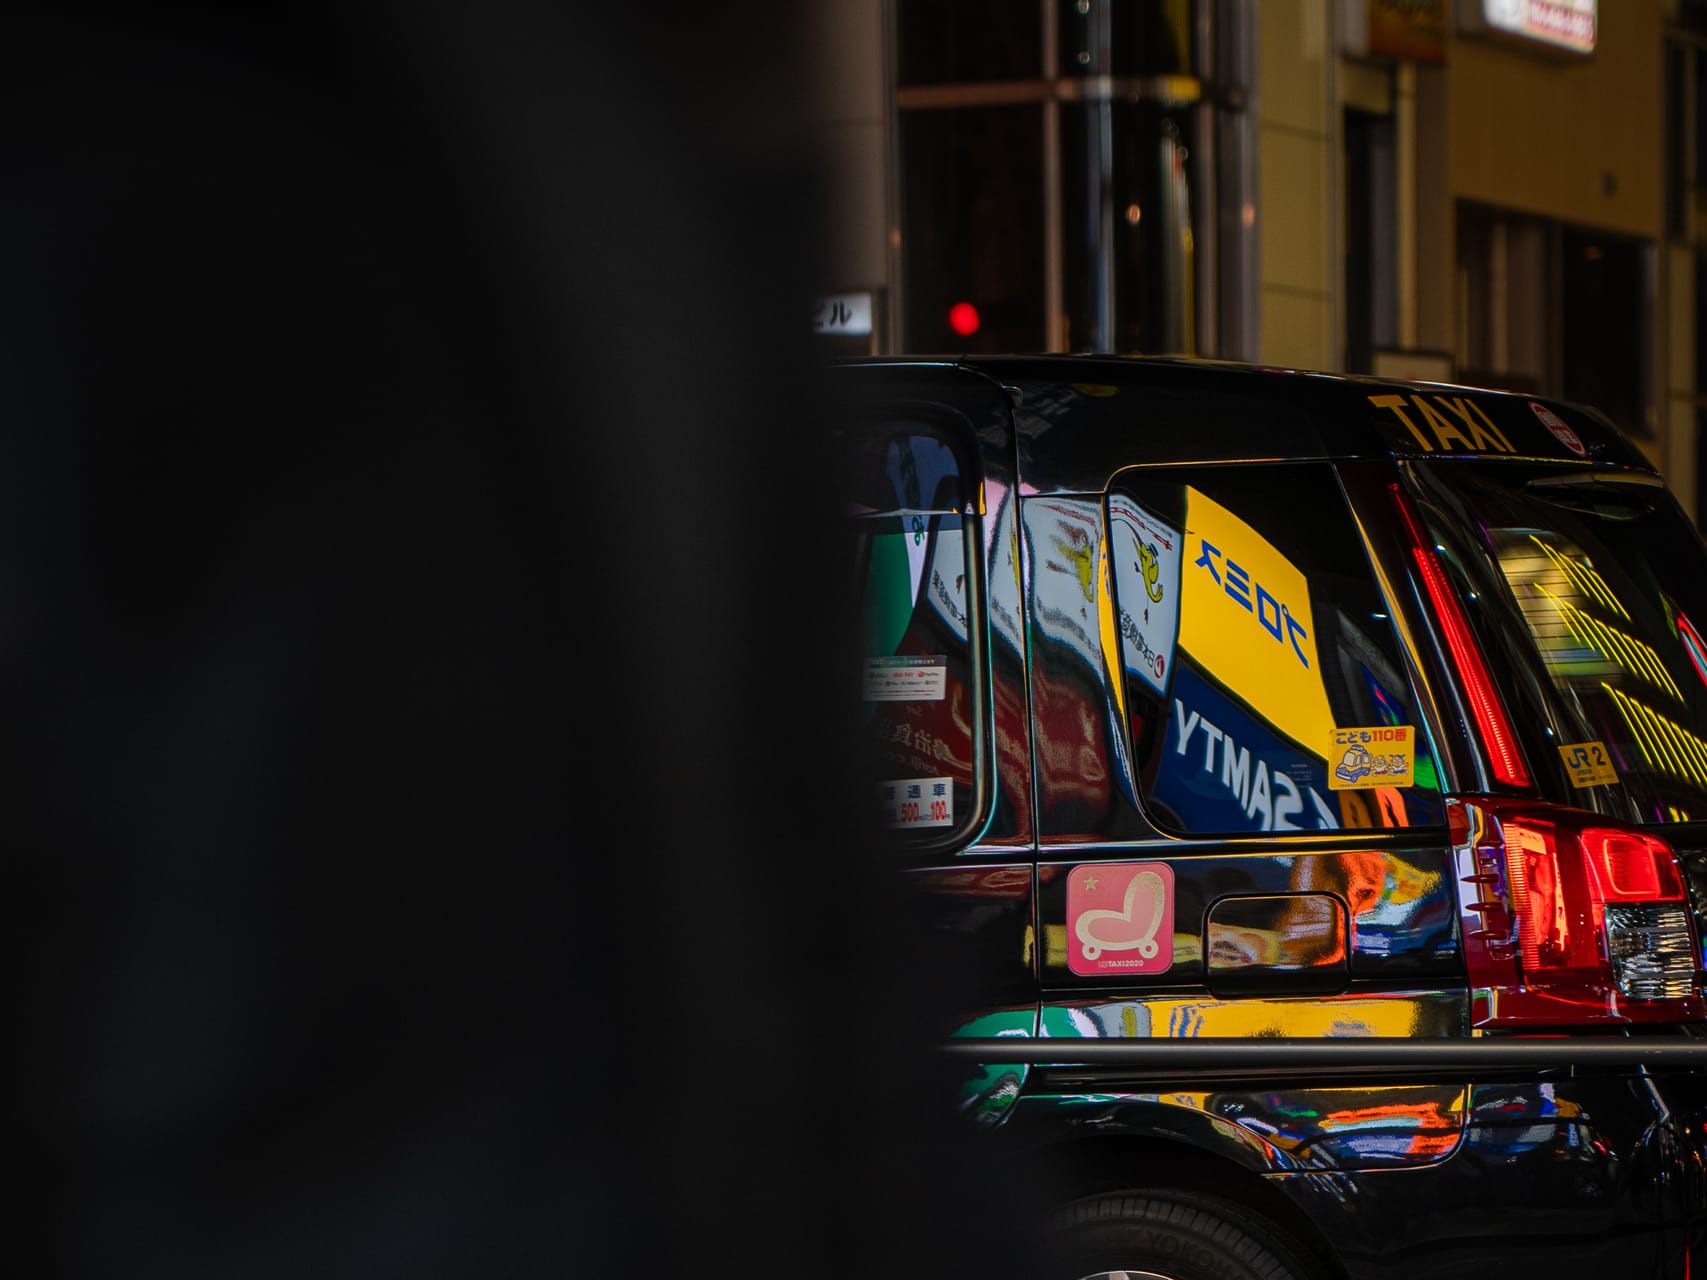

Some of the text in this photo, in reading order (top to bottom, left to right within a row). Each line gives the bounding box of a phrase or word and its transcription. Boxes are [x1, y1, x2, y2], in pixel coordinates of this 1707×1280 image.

[1367, 394, 1518, 454] TAXI
[1335, 728, 1408, 745] こども110番
[1567, 746, 1606, 769] JR 2
